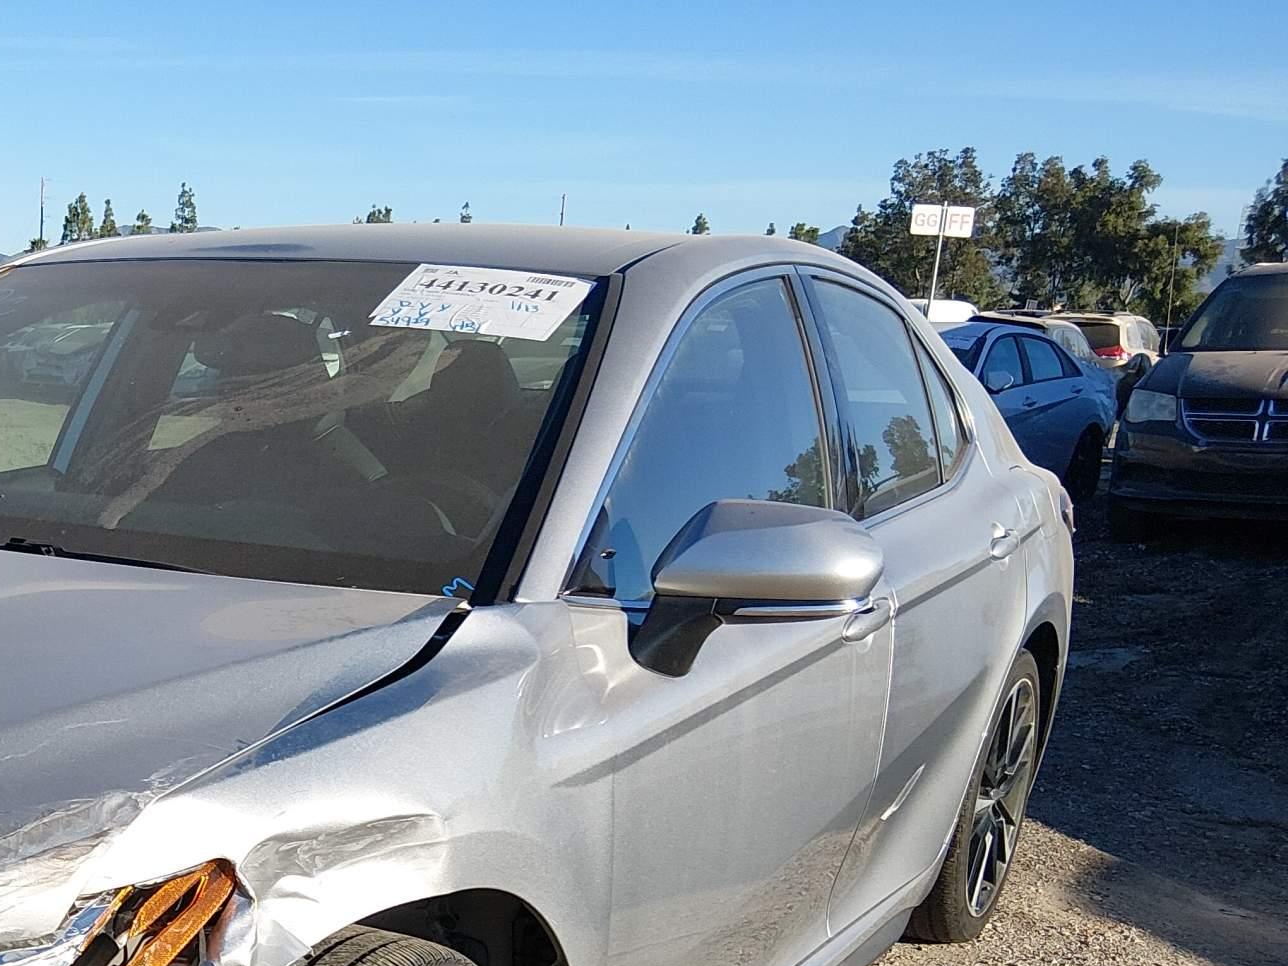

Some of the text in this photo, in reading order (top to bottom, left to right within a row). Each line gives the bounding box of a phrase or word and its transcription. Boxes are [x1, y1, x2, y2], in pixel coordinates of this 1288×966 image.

[914, 212, 938, 228] GG
[948, 213, 971, 231] FF
[418, 278, 559, 301] 44130241
